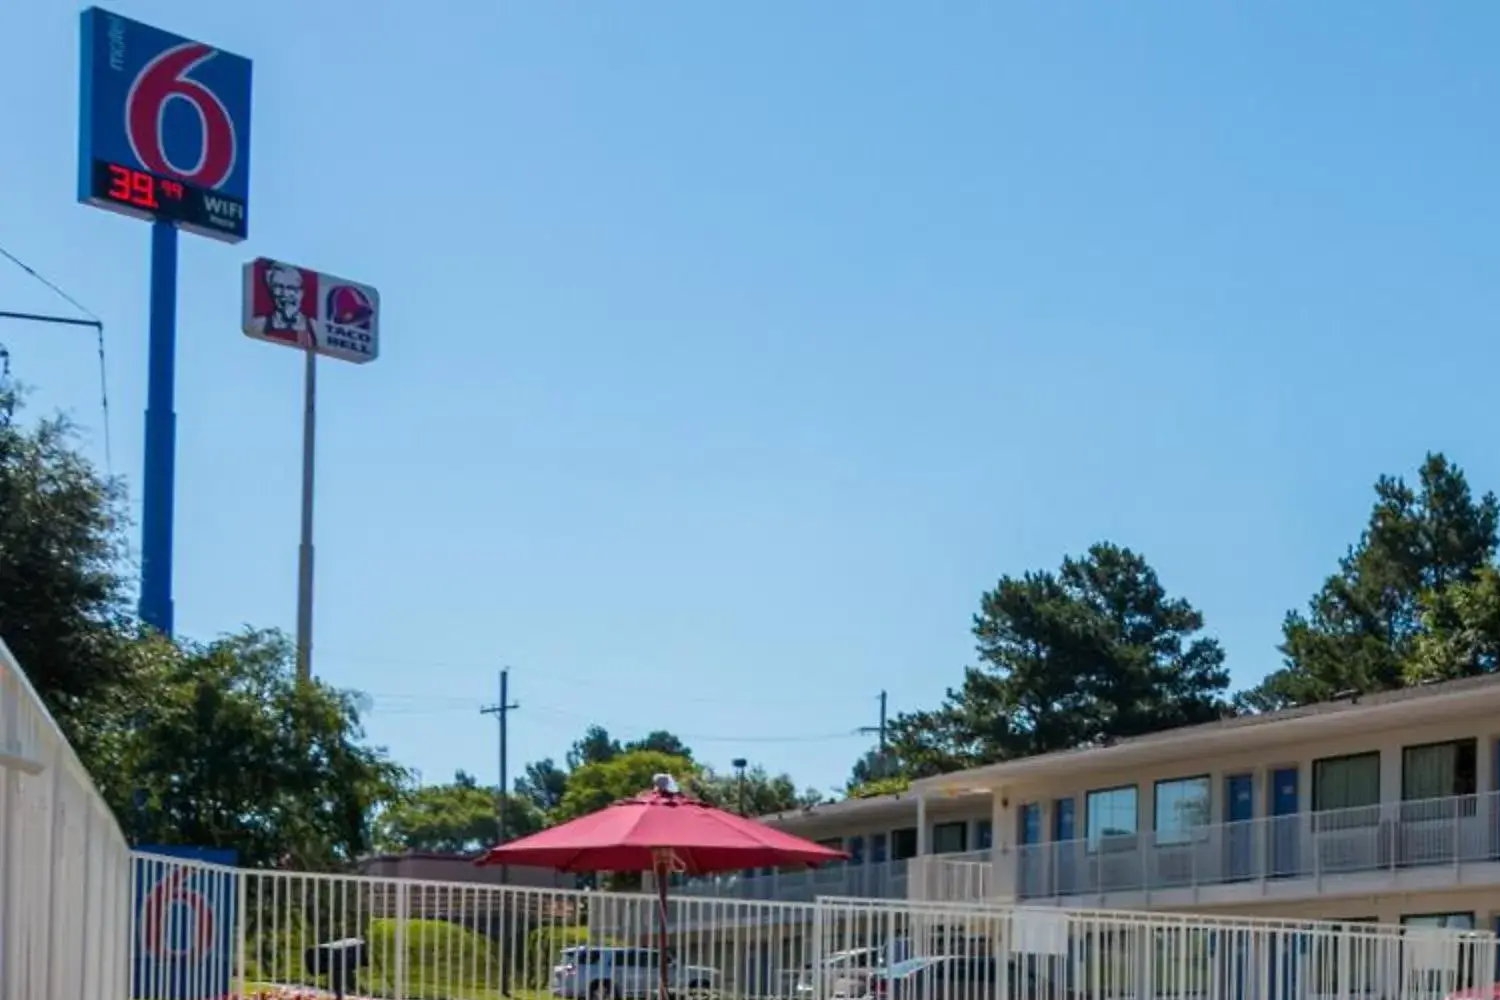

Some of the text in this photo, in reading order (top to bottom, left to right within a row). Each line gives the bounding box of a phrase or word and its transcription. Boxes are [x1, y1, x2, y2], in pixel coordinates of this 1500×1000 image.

[125, 41, 237, 190] 6
[325, 323, 371, 344] TACO
[327, 335, 372, 356] BELL
